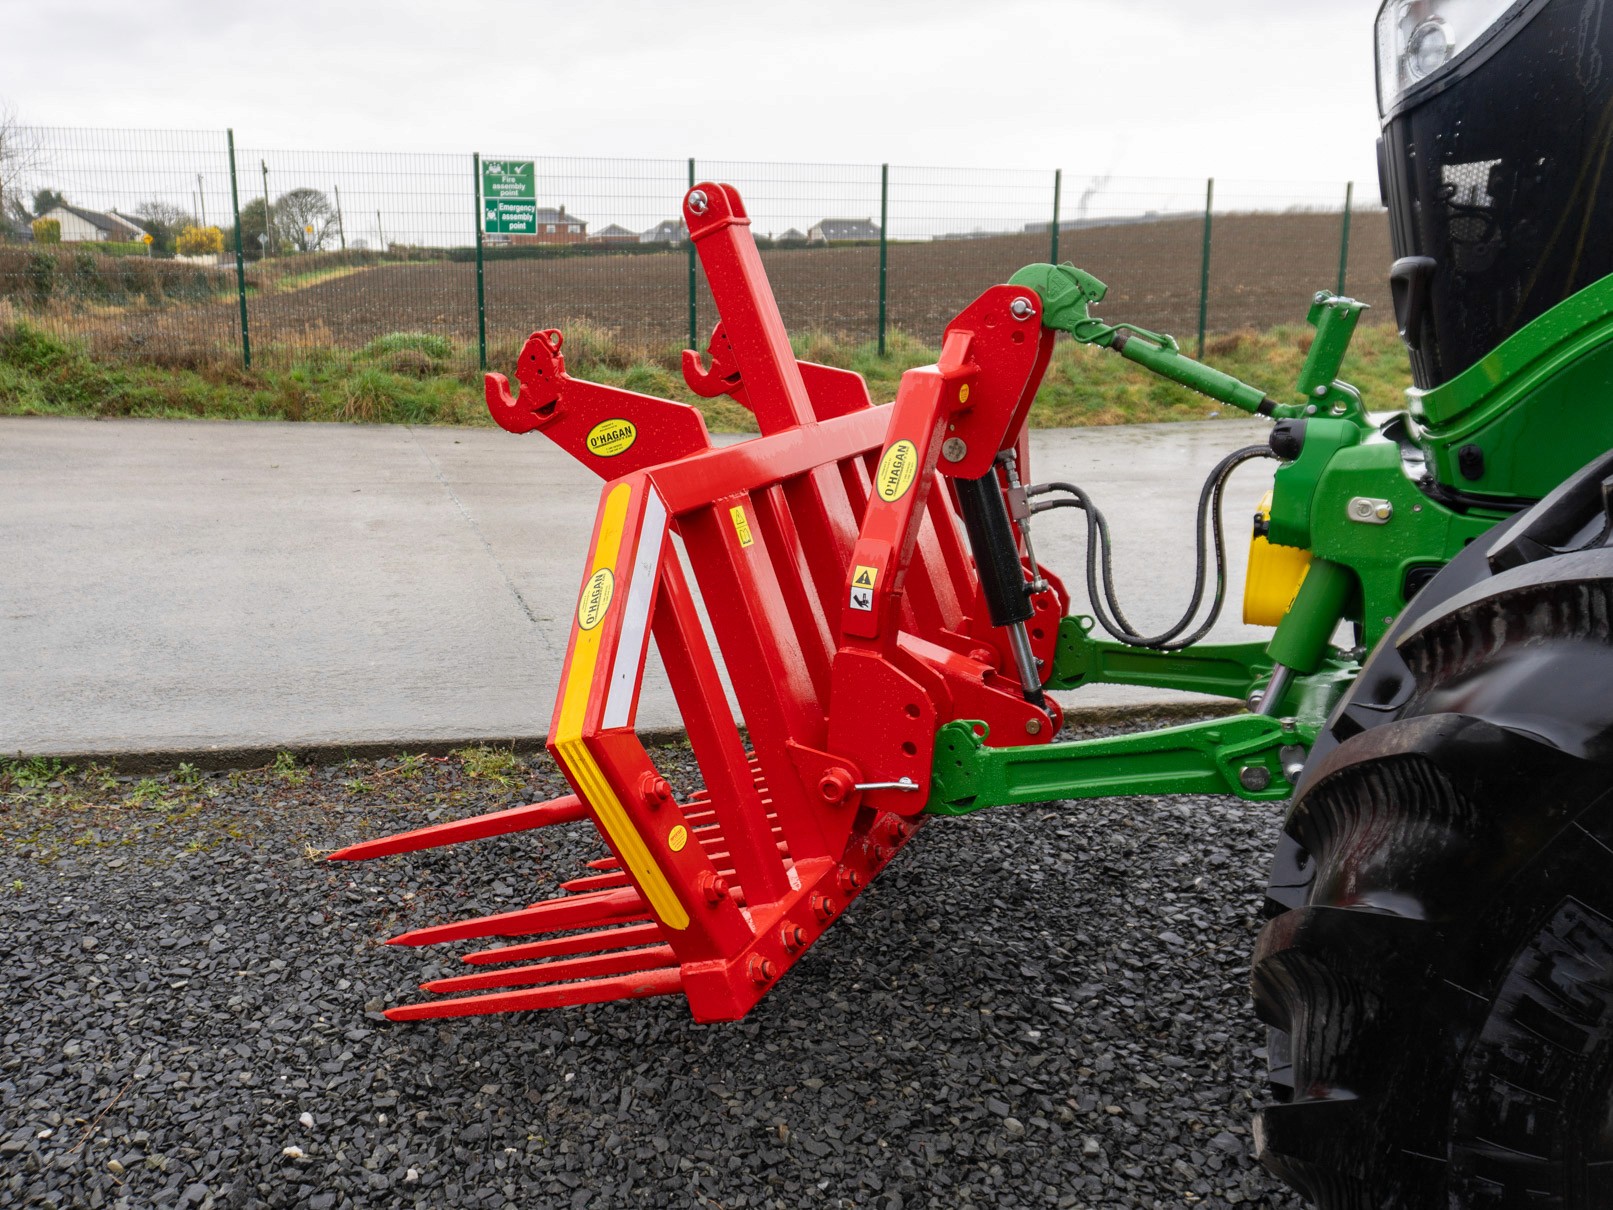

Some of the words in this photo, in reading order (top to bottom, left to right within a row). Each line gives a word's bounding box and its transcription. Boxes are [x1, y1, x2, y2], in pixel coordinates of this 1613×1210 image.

[492, 183, 526, 191] assembly
[499, 203, 536, 213] Emergency
[501, 212, 533, 222] assembly
[508, 221, 526, 230] point
[590, 425, 632, 447] O'HAGAN
[884, 445, 907, 496] O'HAGAN
[586, 573, 604, 625] O'HAGAN
